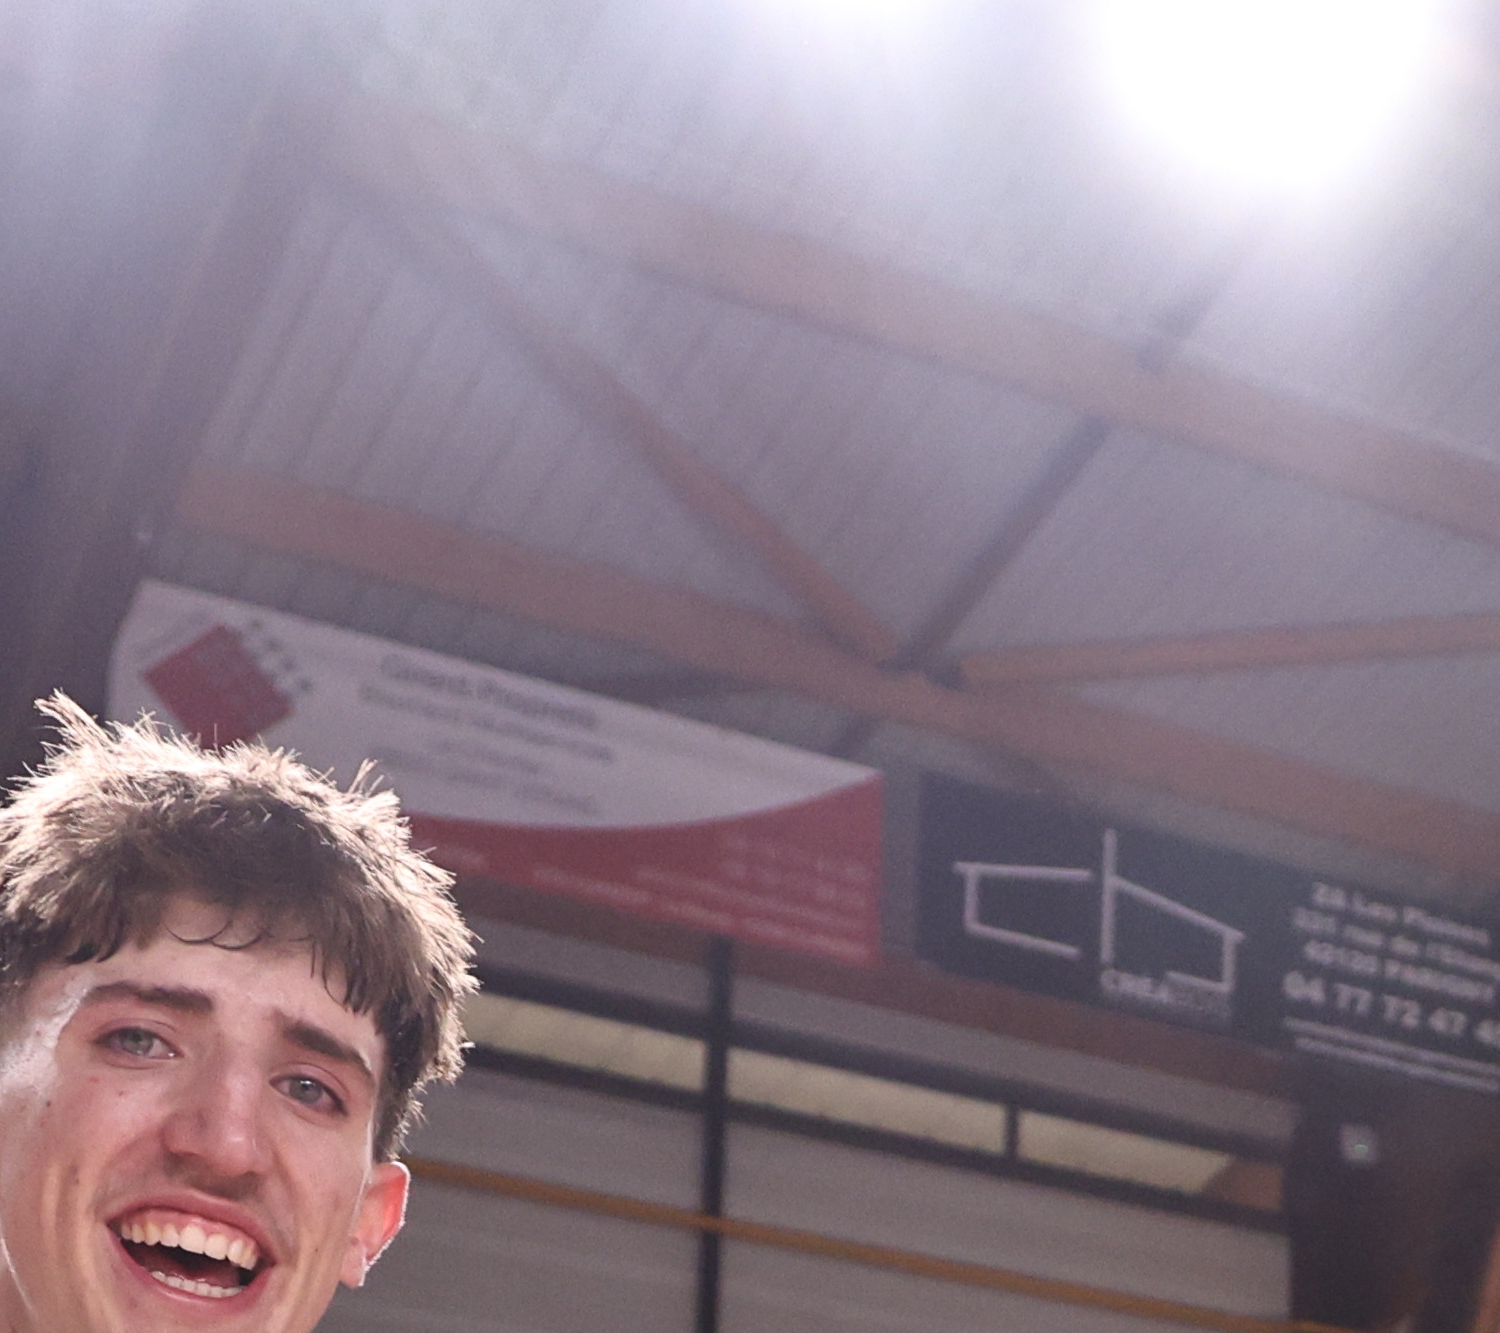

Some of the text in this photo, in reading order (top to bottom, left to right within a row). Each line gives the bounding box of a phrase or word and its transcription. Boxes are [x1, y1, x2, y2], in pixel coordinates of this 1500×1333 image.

[1282, 969, 1326, 1006] 04
[1334, 981, 1372, 1015] 77
[1383, 994, 1422, 1030] 72
[1427, 1006, 1467, 1038] 47
